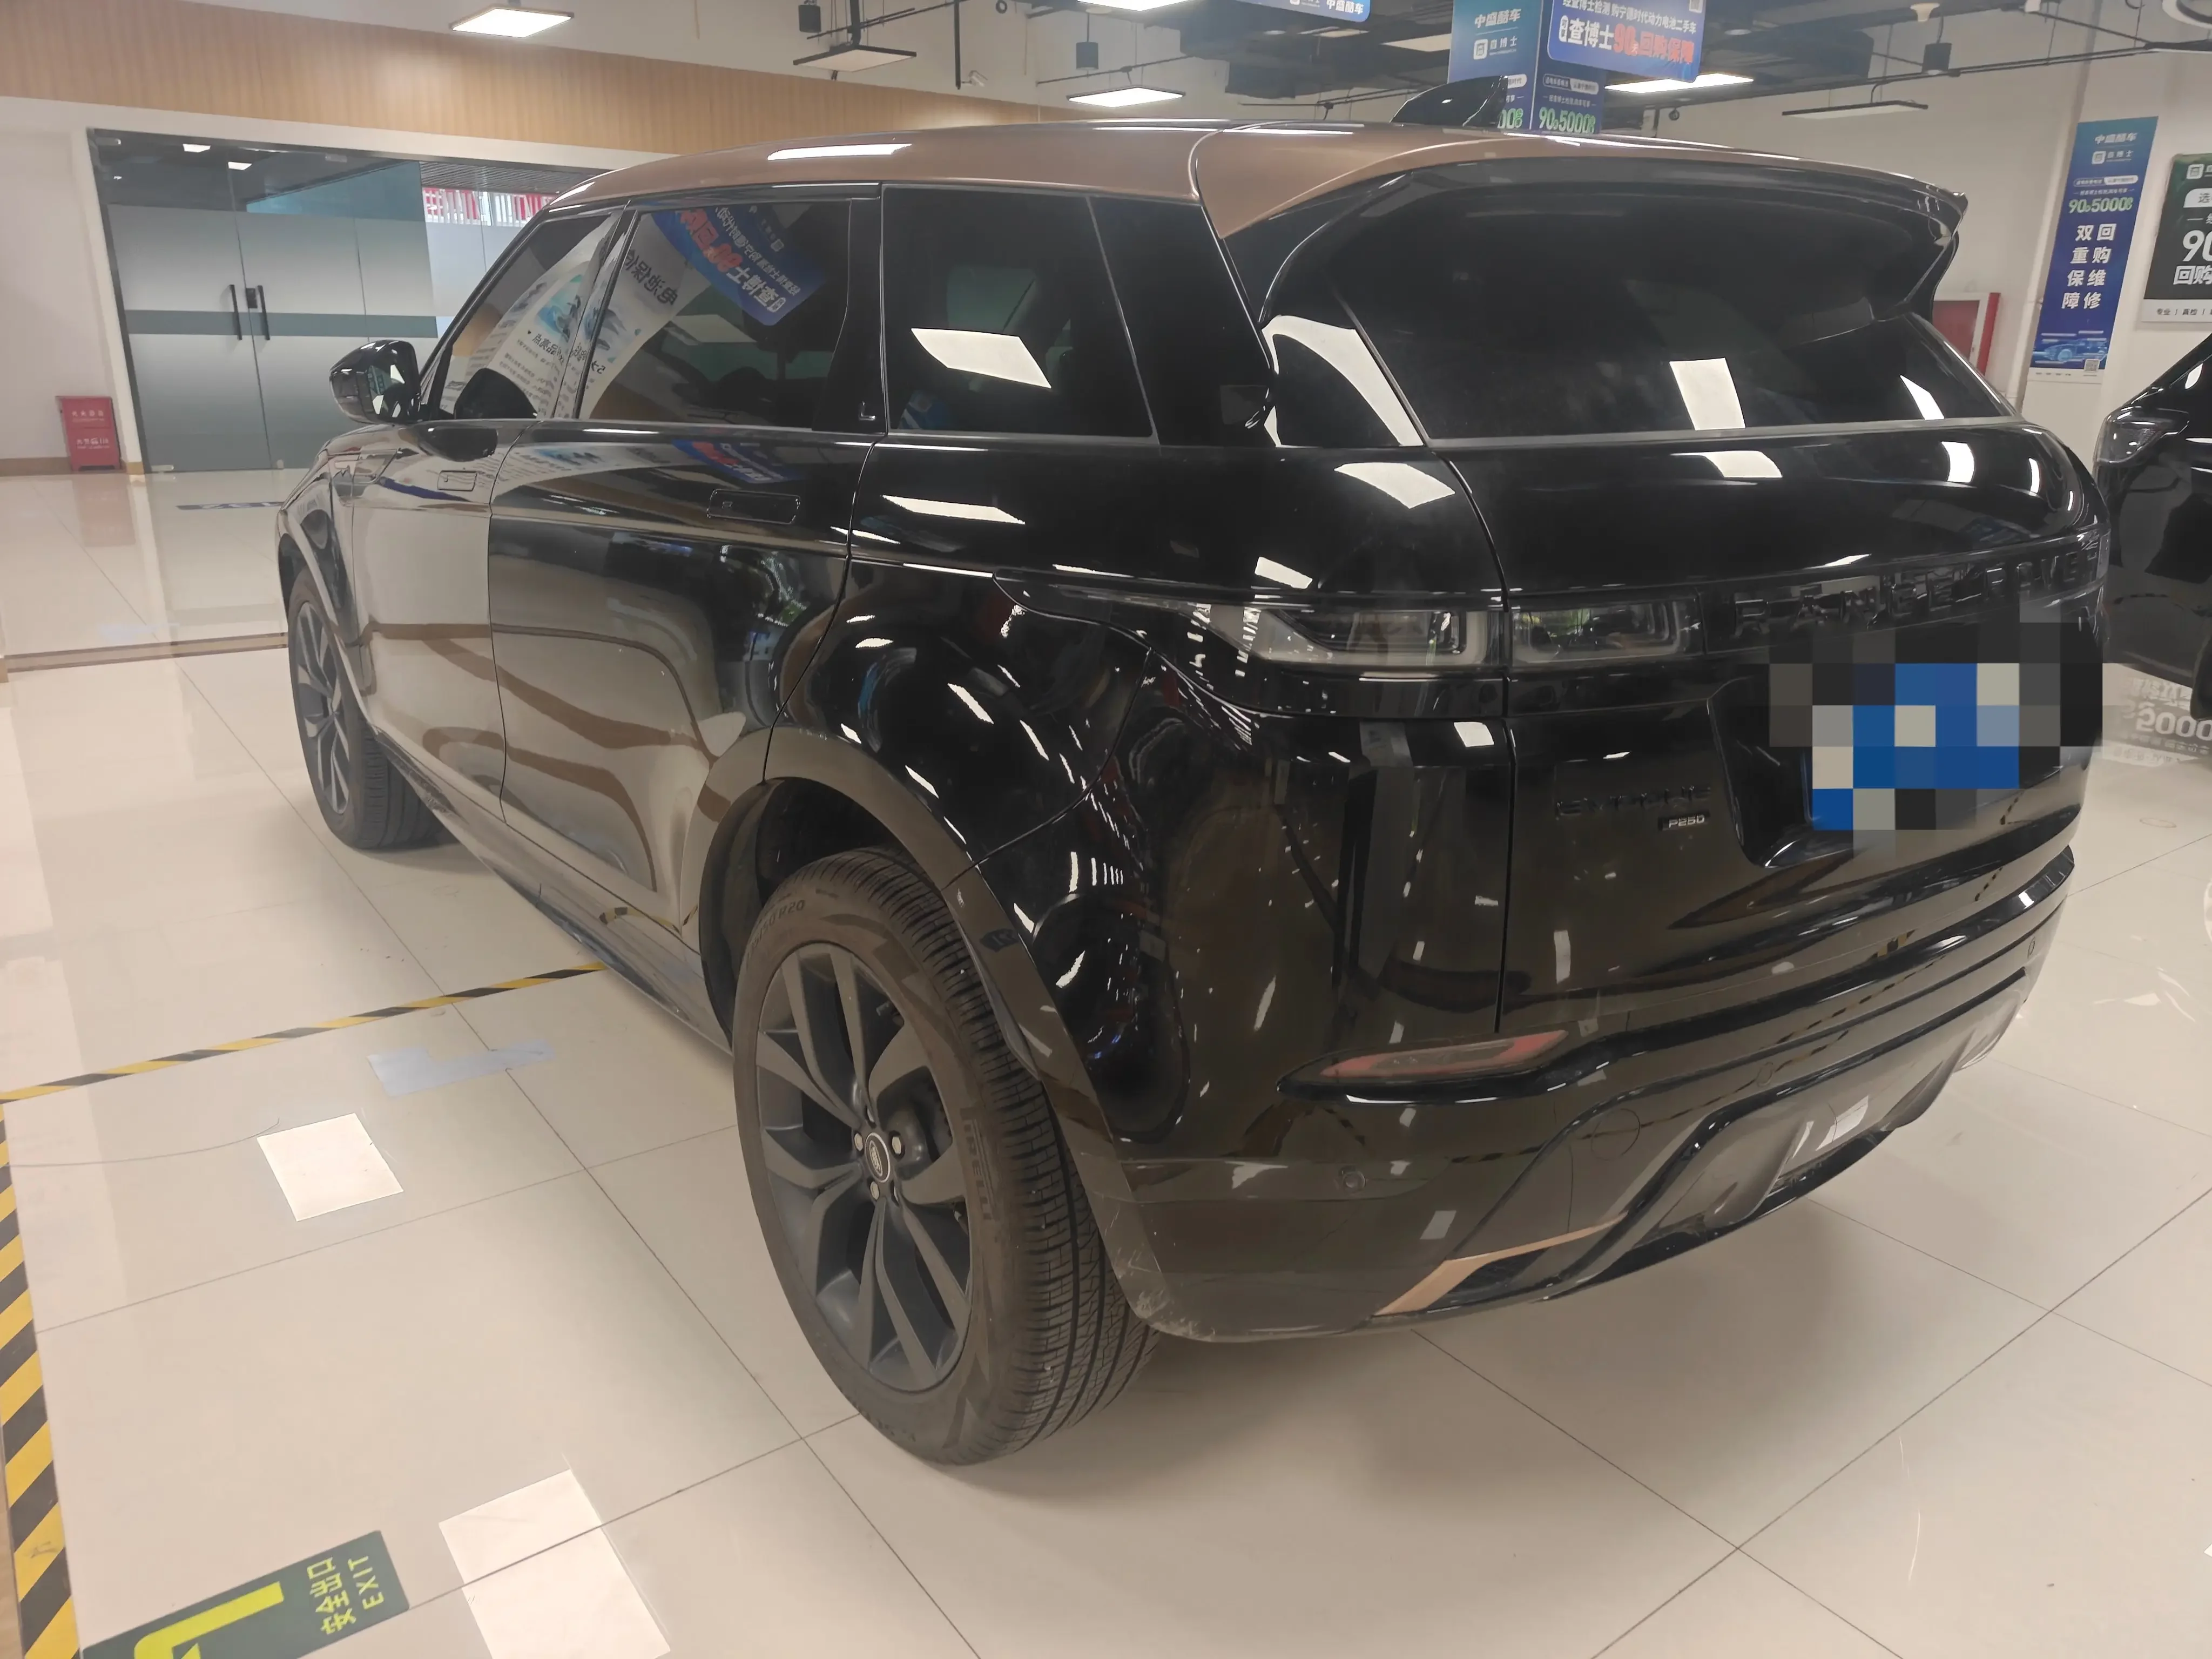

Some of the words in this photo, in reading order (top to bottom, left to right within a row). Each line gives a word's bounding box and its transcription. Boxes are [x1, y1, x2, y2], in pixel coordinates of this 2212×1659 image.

[307, 1557, 357, 1635] 安全出口
[348, 1555, 384, 1610] EXIT
